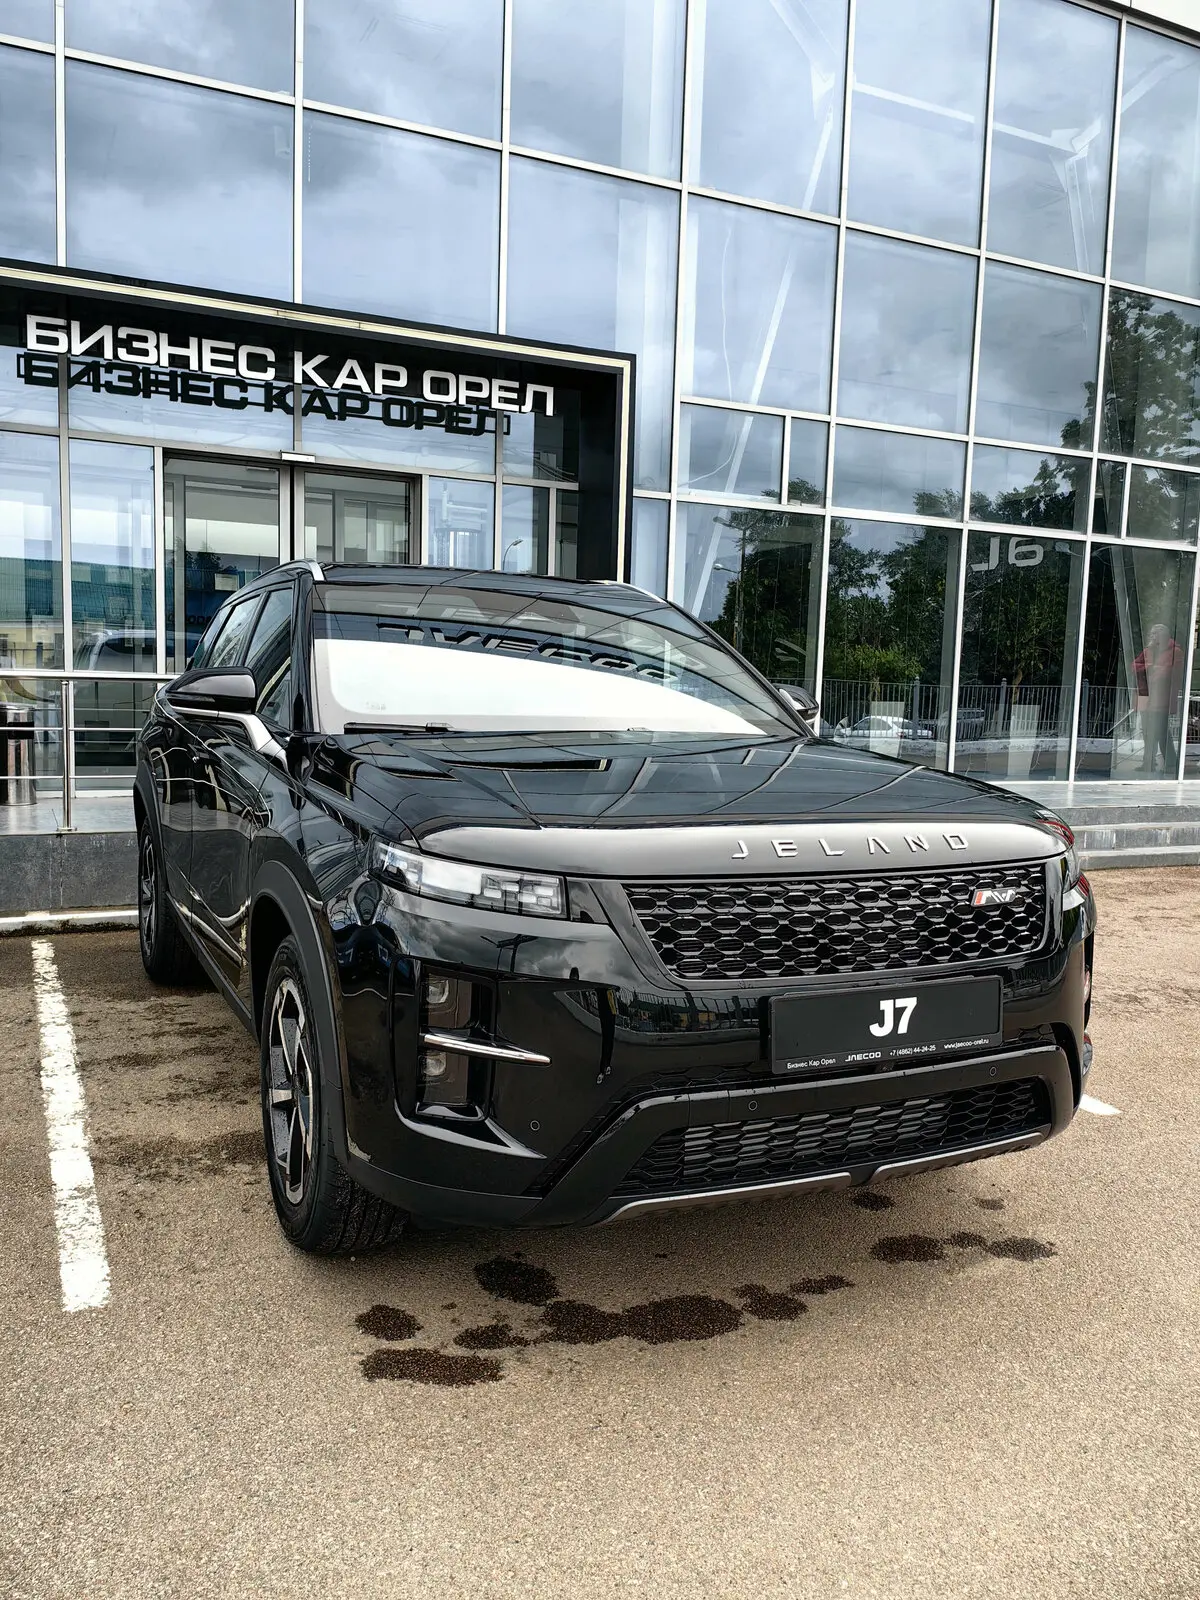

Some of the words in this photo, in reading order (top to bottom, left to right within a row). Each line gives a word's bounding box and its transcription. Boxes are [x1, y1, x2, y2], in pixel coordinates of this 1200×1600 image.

[23, 351, 249, 411] БИЗНЕС
[27, 314, 276, 381] БИЗНЕС
[293, 350, 408, 395] КАР
[422, 369, 554, 417] ОРЕЛ
[970, 535, 1044, 572] J6
[731, 831, 969, 859] JELAND
[869, 996, 918, 1037] J7
[808, 1059, 820, 1068] Кар
[845, 1051, 882, 1062] JAECOO
